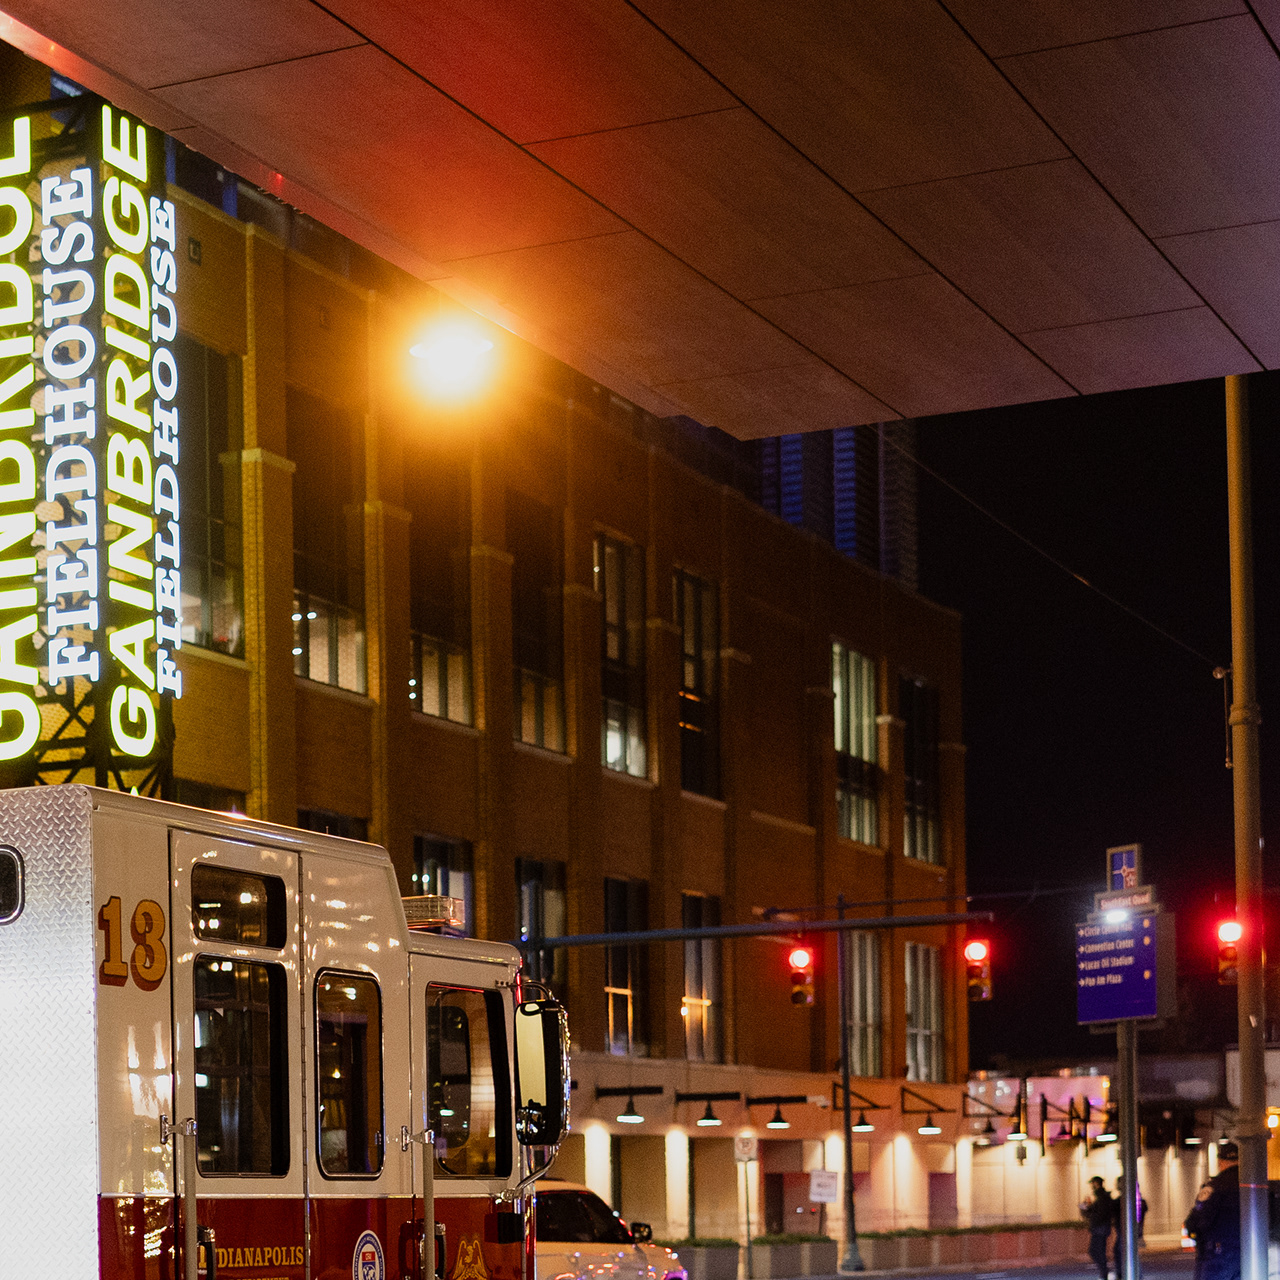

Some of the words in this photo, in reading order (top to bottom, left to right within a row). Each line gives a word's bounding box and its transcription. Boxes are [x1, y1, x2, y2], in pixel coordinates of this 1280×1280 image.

[41, 167, 100, 687] FIELDHOUSE
[101, 104, 158, 758] GAINBRIDGE
[150, 196, 183, 700] FIELDHOUSE
[97, 894, 168, 992] 13
[198, 1244, 305, 1269] IDIANAPOLIS
